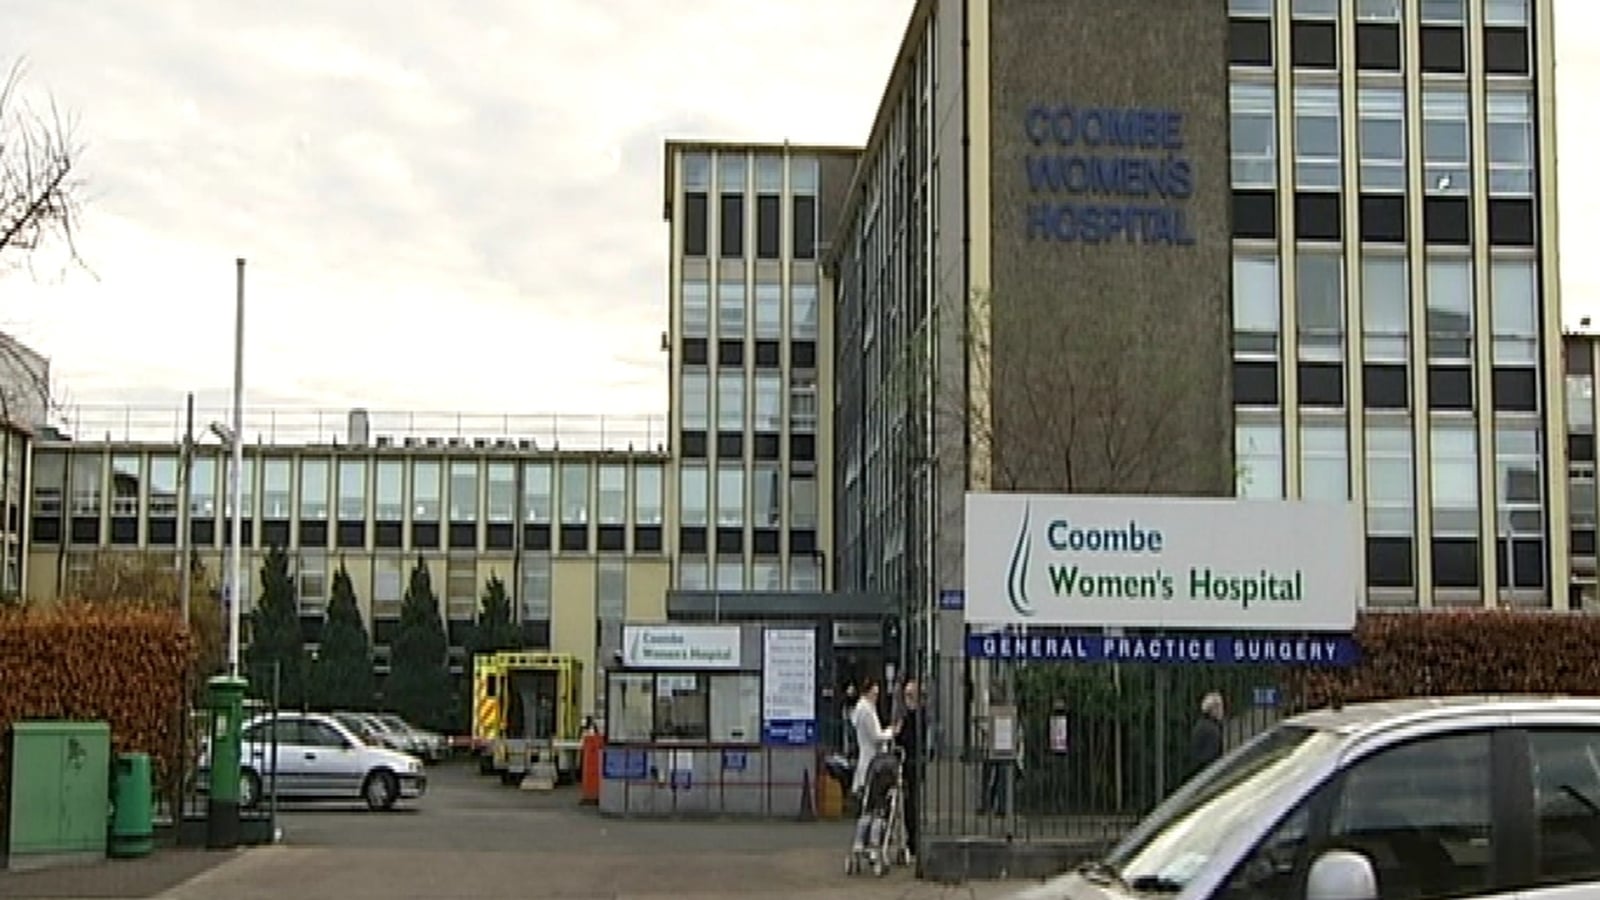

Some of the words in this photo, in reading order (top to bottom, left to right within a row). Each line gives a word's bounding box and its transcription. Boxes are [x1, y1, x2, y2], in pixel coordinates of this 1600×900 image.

[1025, 105, 1184, 149] COOMBE
[1026, 154, 1193, 199] WOMEN'S
[1027, 203, 1195, 246] HOSPITAL
[1047, 519, 1163, 552] Coombe
[1048, 565, 1174, 600] Women's
[1189, 566, 1303, 610] Hospital
[983, 637, 1088, 658] GENERAL
[1103, 638, 1215, 660] PRACTICE
[1234, 639, 1336, 661] SURGERY
